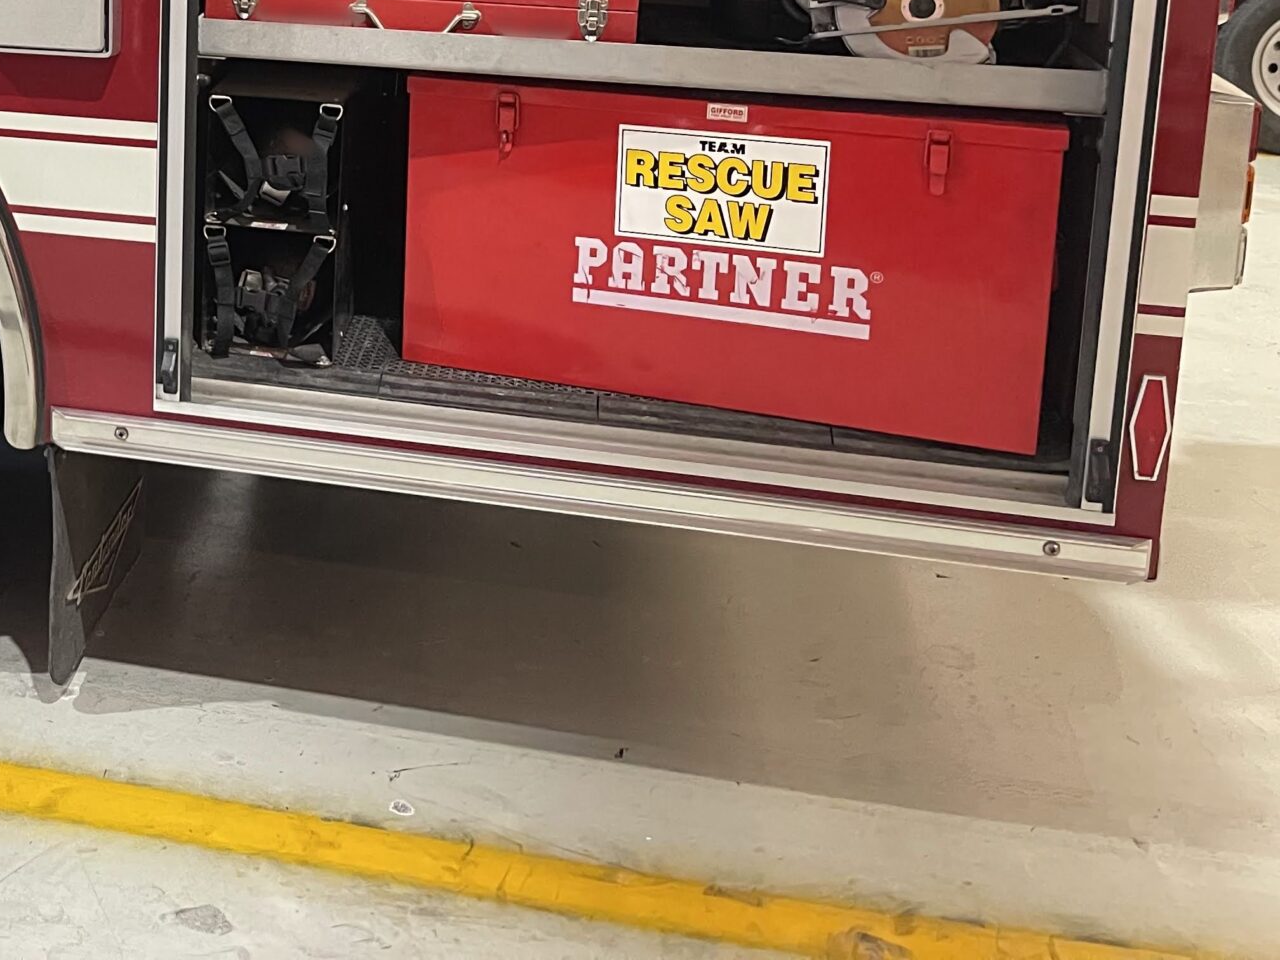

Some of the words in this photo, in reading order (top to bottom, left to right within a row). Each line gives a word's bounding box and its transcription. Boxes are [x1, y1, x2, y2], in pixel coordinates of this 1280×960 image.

[710, 107, 744, 116] GIFFORD
[699, 140, 746, 155] TEAM
[625, 149, 819, 204] RESCUE
[664, 194, 774, 242] SAW
[573, 236, 871, 320] PARTNER
